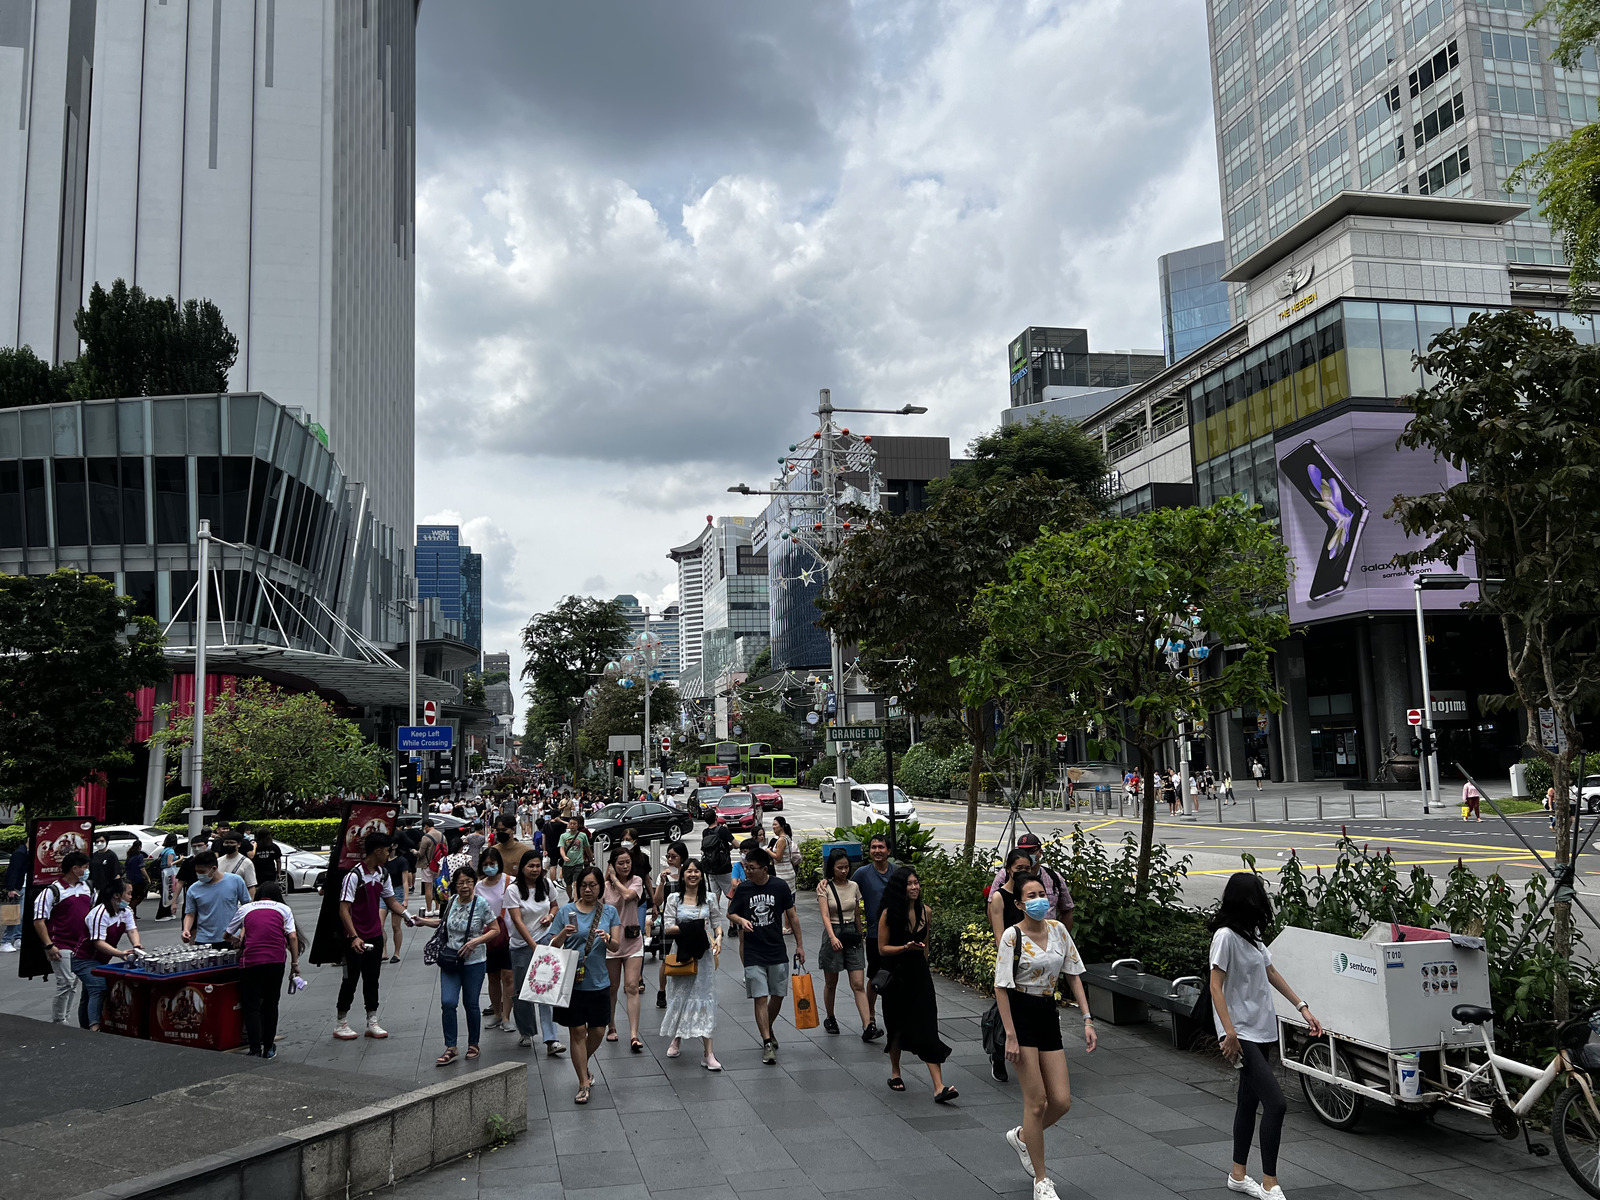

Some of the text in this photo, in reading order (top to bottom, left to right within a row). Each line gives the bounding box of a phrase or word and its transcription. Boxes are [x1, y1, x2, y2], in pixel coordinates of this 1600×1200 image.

[1278, 292, 1318, 322] THE HEEREN
[1360, 562, 1398, 573] Galaxy
[1382, 567, 1433, 579] samsung.com
[1431, 698, 1467, 714] nojima
[410, 730, 427, 738] Keep
[831, 728, 880, 739] GRANGE RD
[402, 739, 449, 748] While Crossing
[749, 893, 775, 909] ADIDAS
[1386, 951, 1402, 960] T 010
[1349, 962, 1377, 976] sembcorp
